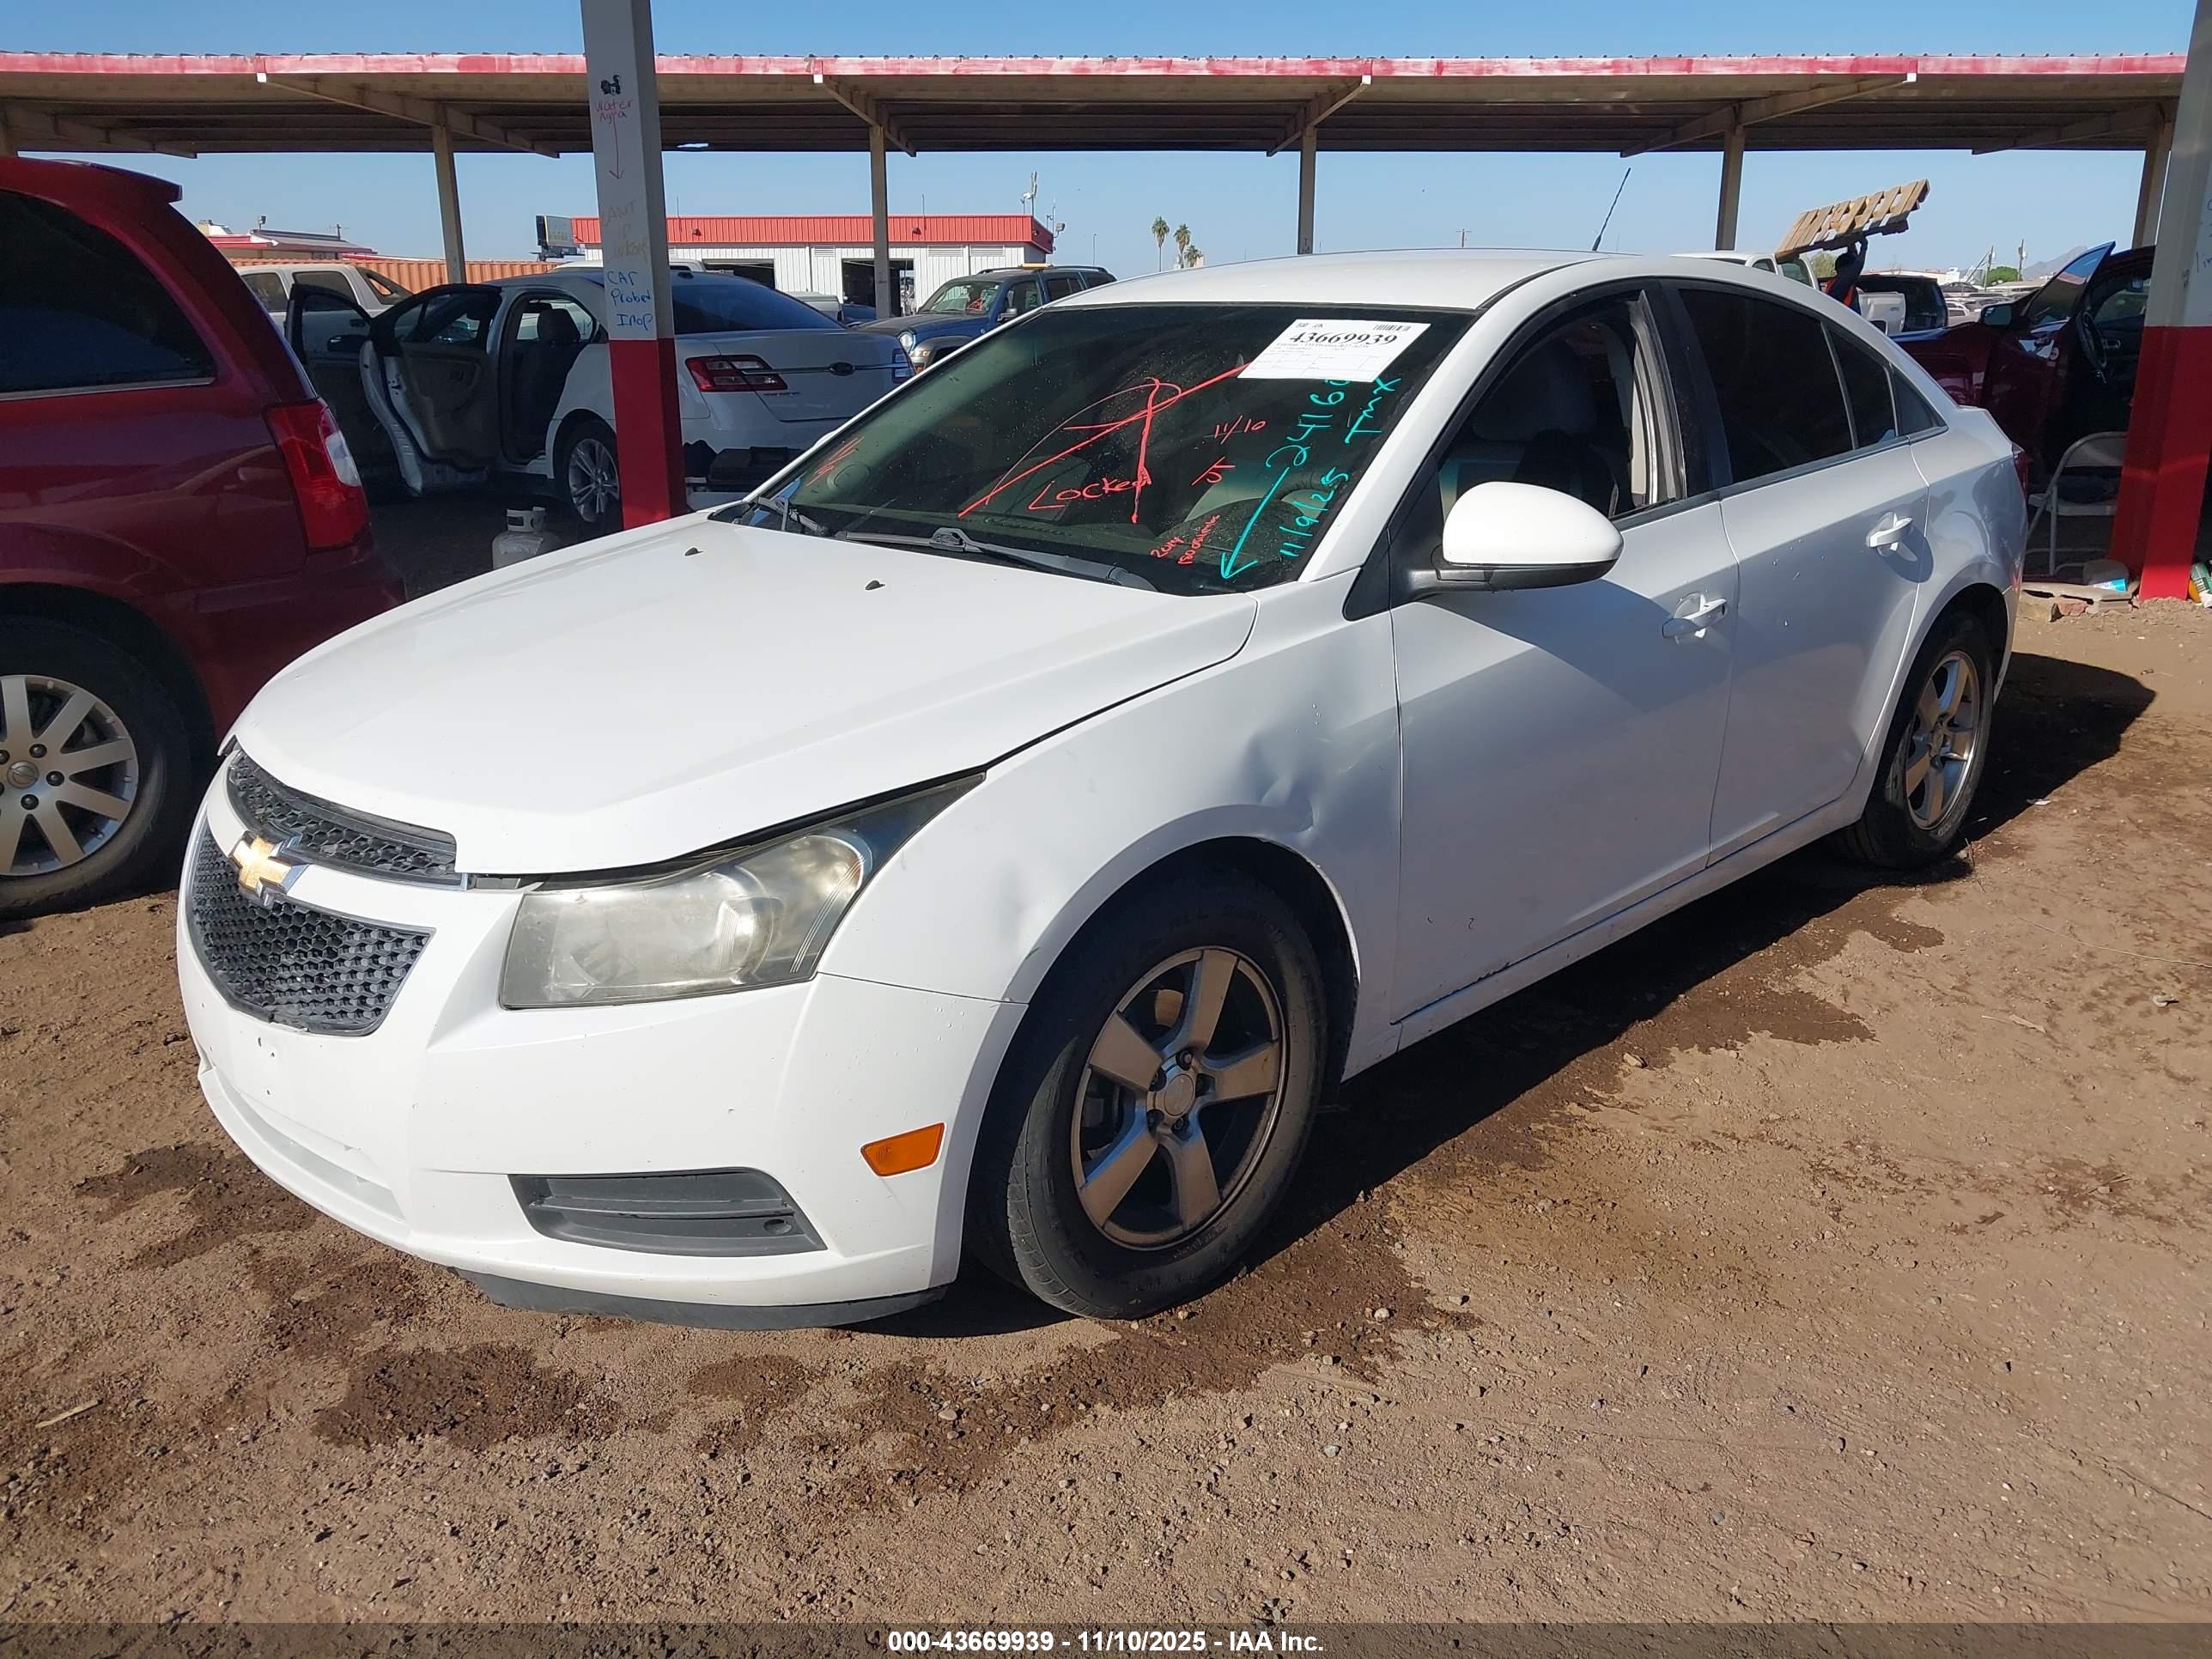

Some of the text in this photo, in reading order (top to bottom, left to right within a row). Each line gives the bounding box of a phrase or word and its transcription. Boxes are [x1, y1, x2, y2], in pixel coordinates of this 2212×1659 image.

[1289, 331, 1398, 345] 43669939
[1214, 415, 1267, 445] 11/10
[1279, 467, 1349, 556] 11/9/25
